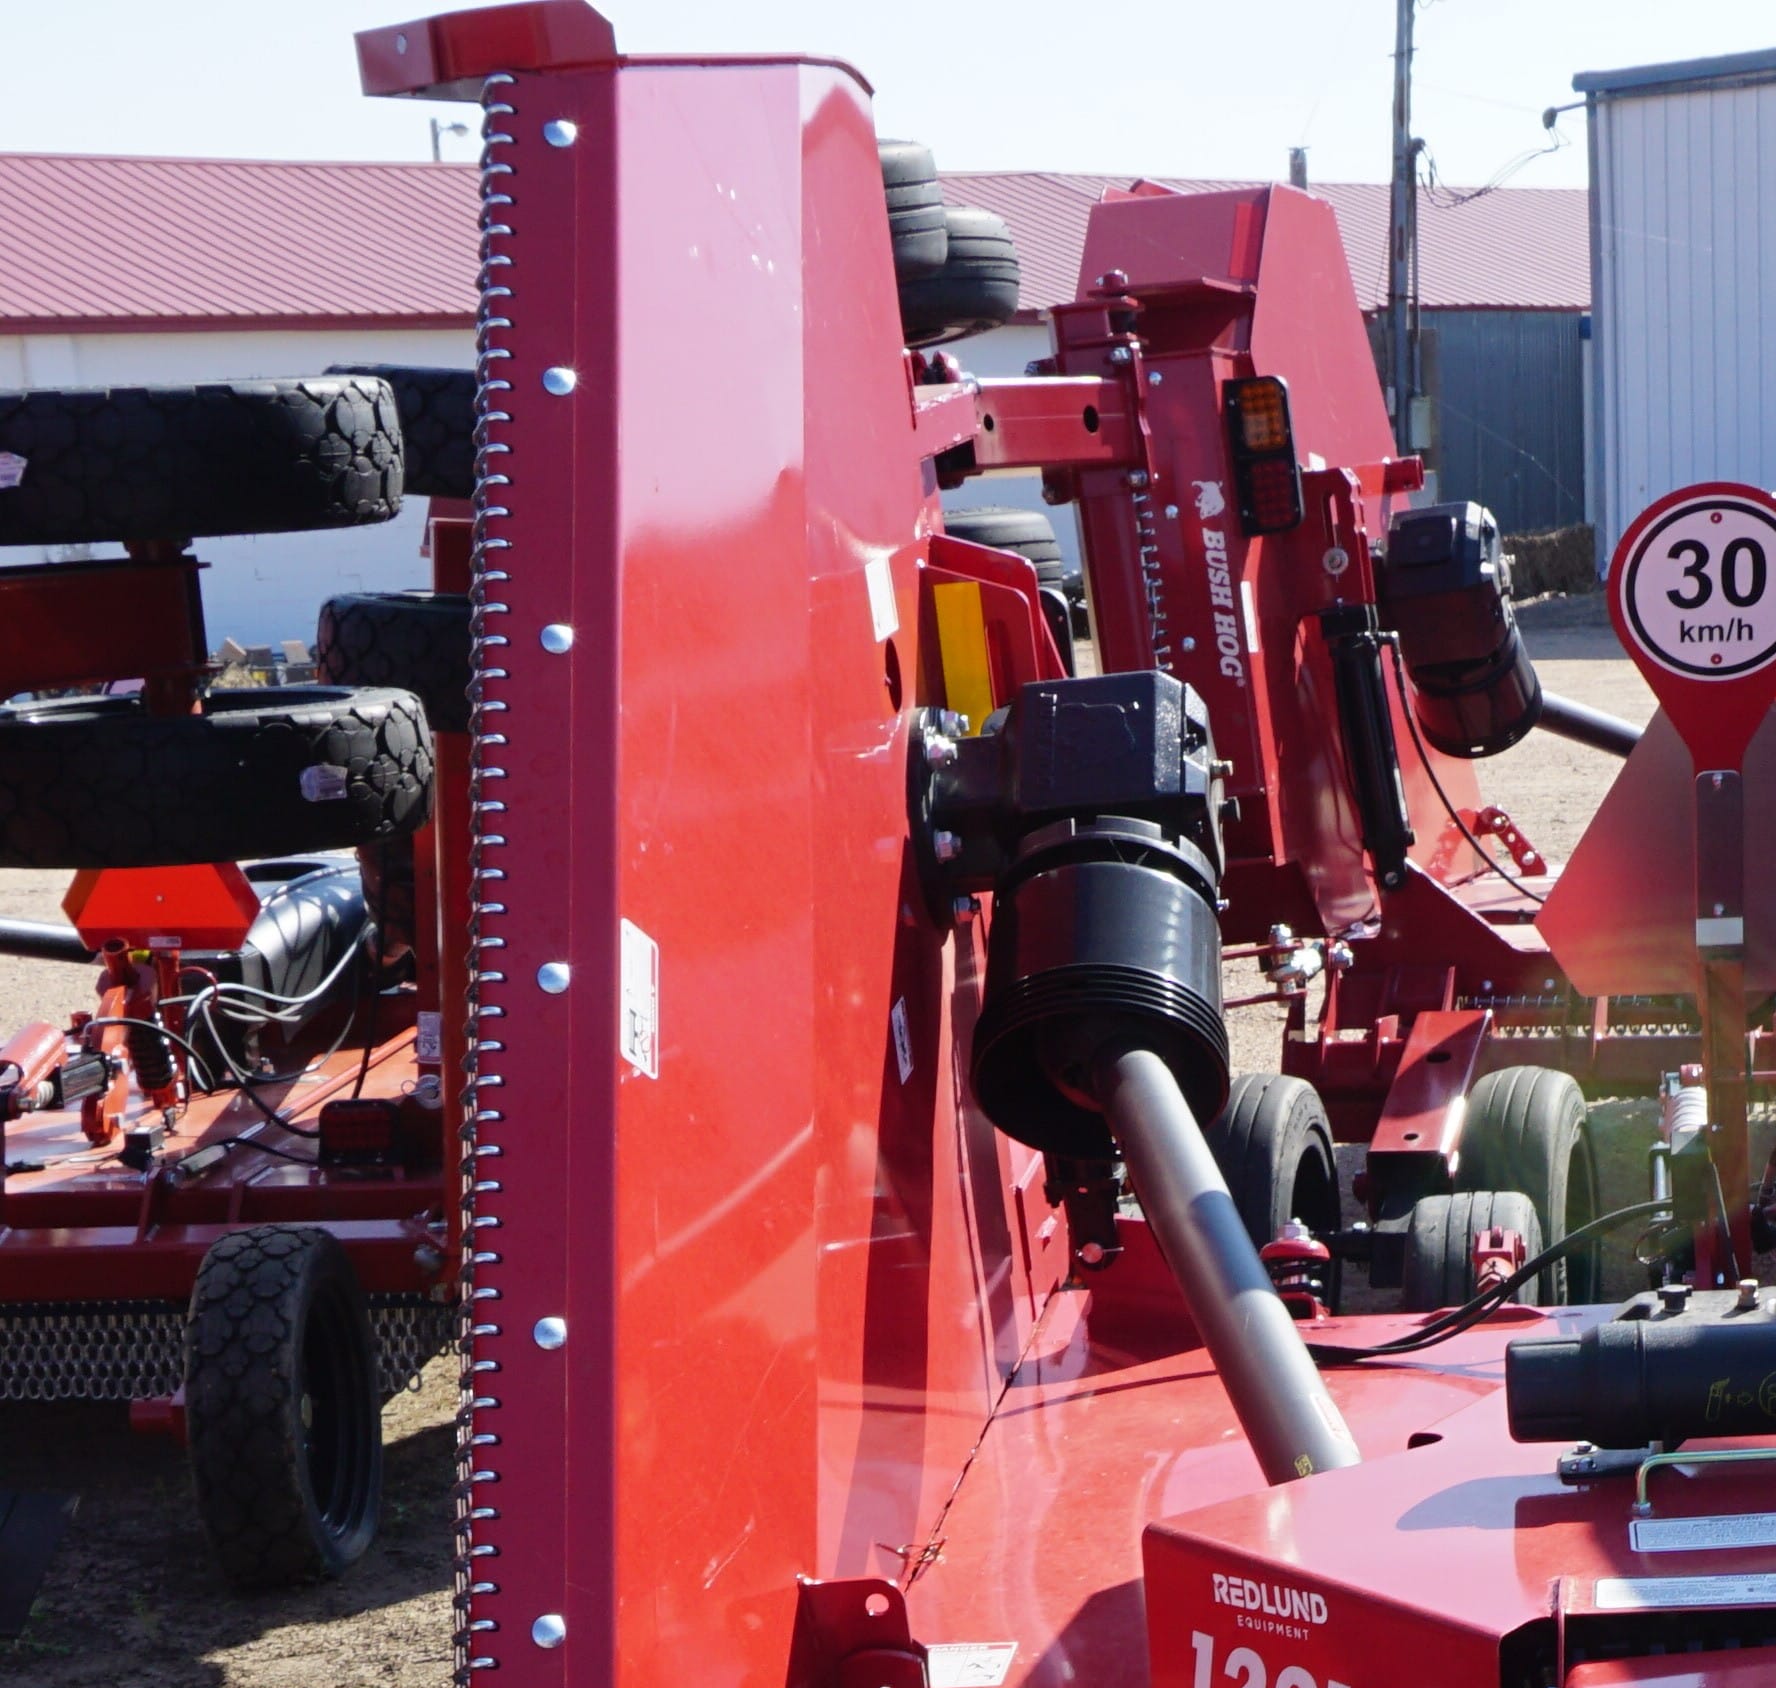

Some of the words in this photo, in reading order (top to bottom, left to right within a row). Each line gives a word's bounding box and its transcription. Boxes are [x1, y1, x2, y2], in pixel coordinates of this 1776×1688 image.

[1203, 528, 1234, 614] BUSH
[1666, 537, 1767, 610] 30
[1212, 616, 1243, 676] HOG
[1679, 618, 1754, 643] km/h
[1212, 1573, 1328, 1624] REDLUND
[1236, 1614, 1309, 1641] EQUIPMENT
